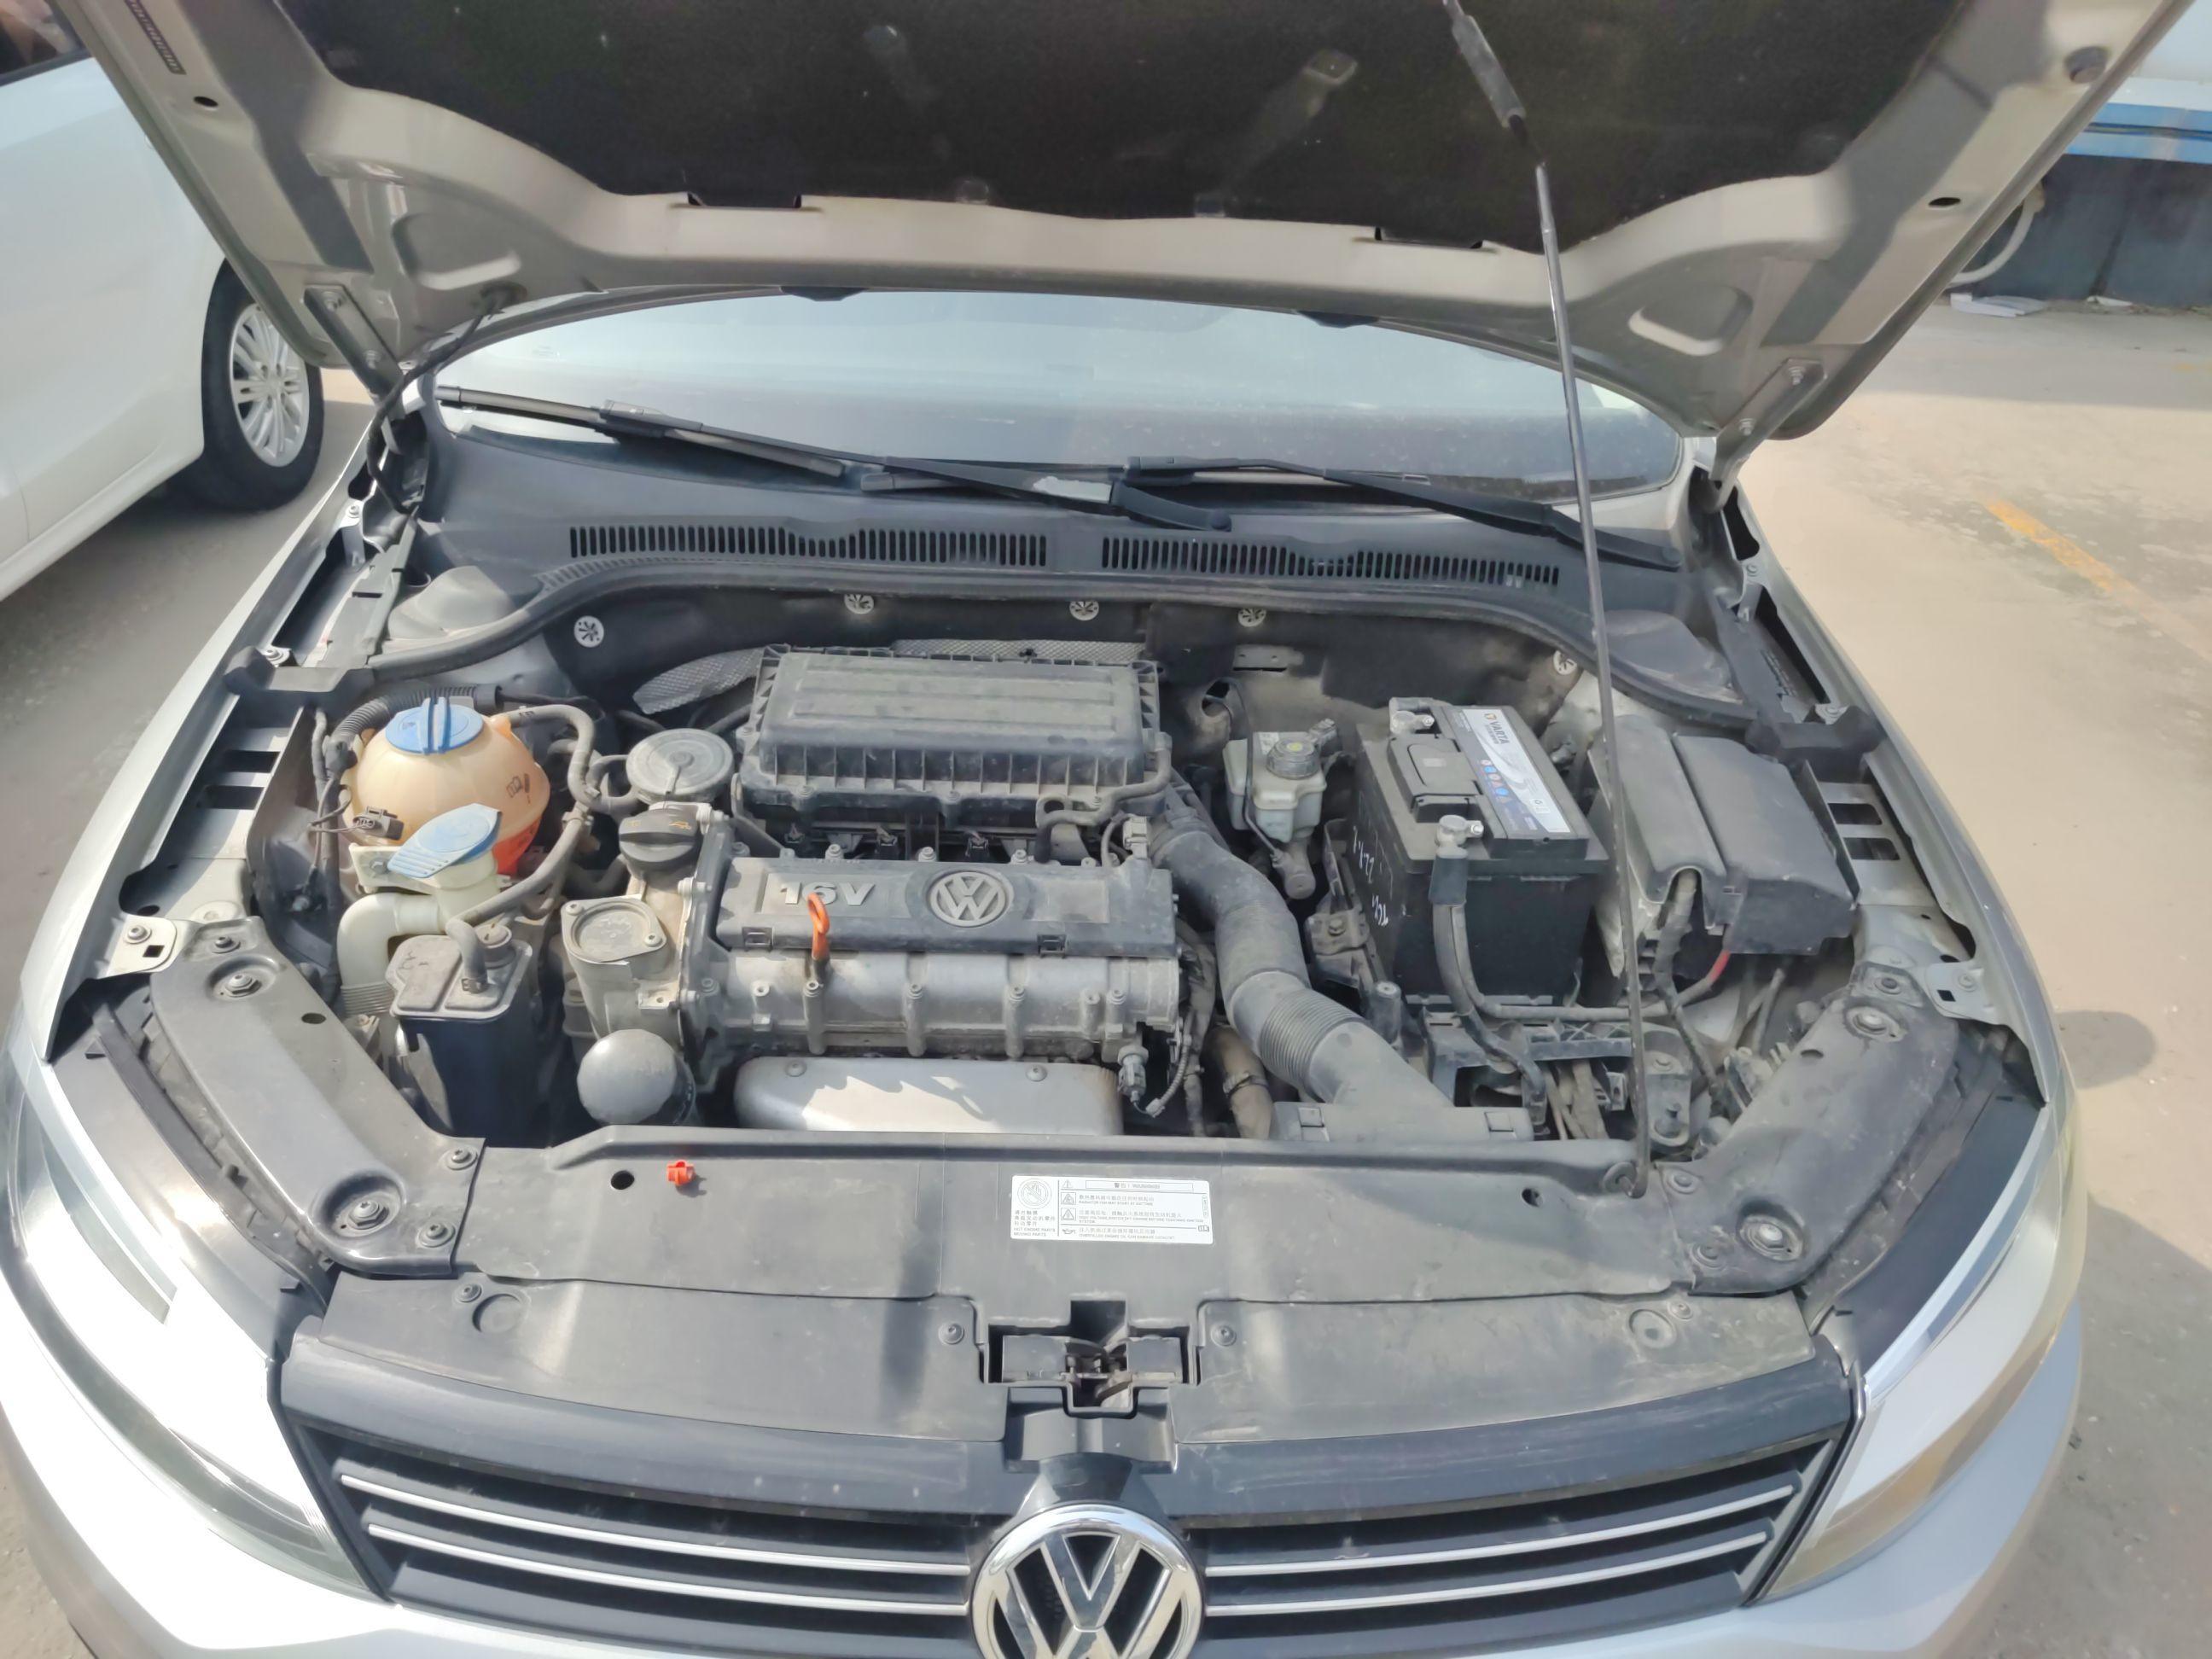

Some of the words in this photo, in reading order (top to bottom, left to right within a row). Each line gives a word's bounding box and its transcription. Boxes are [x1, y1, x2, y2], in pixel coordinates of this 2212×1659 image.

[1489, 721, 1510, 744] VARTA
[780, 882, 875, 906] 16V
[934, 874, 1004, 923] VW
